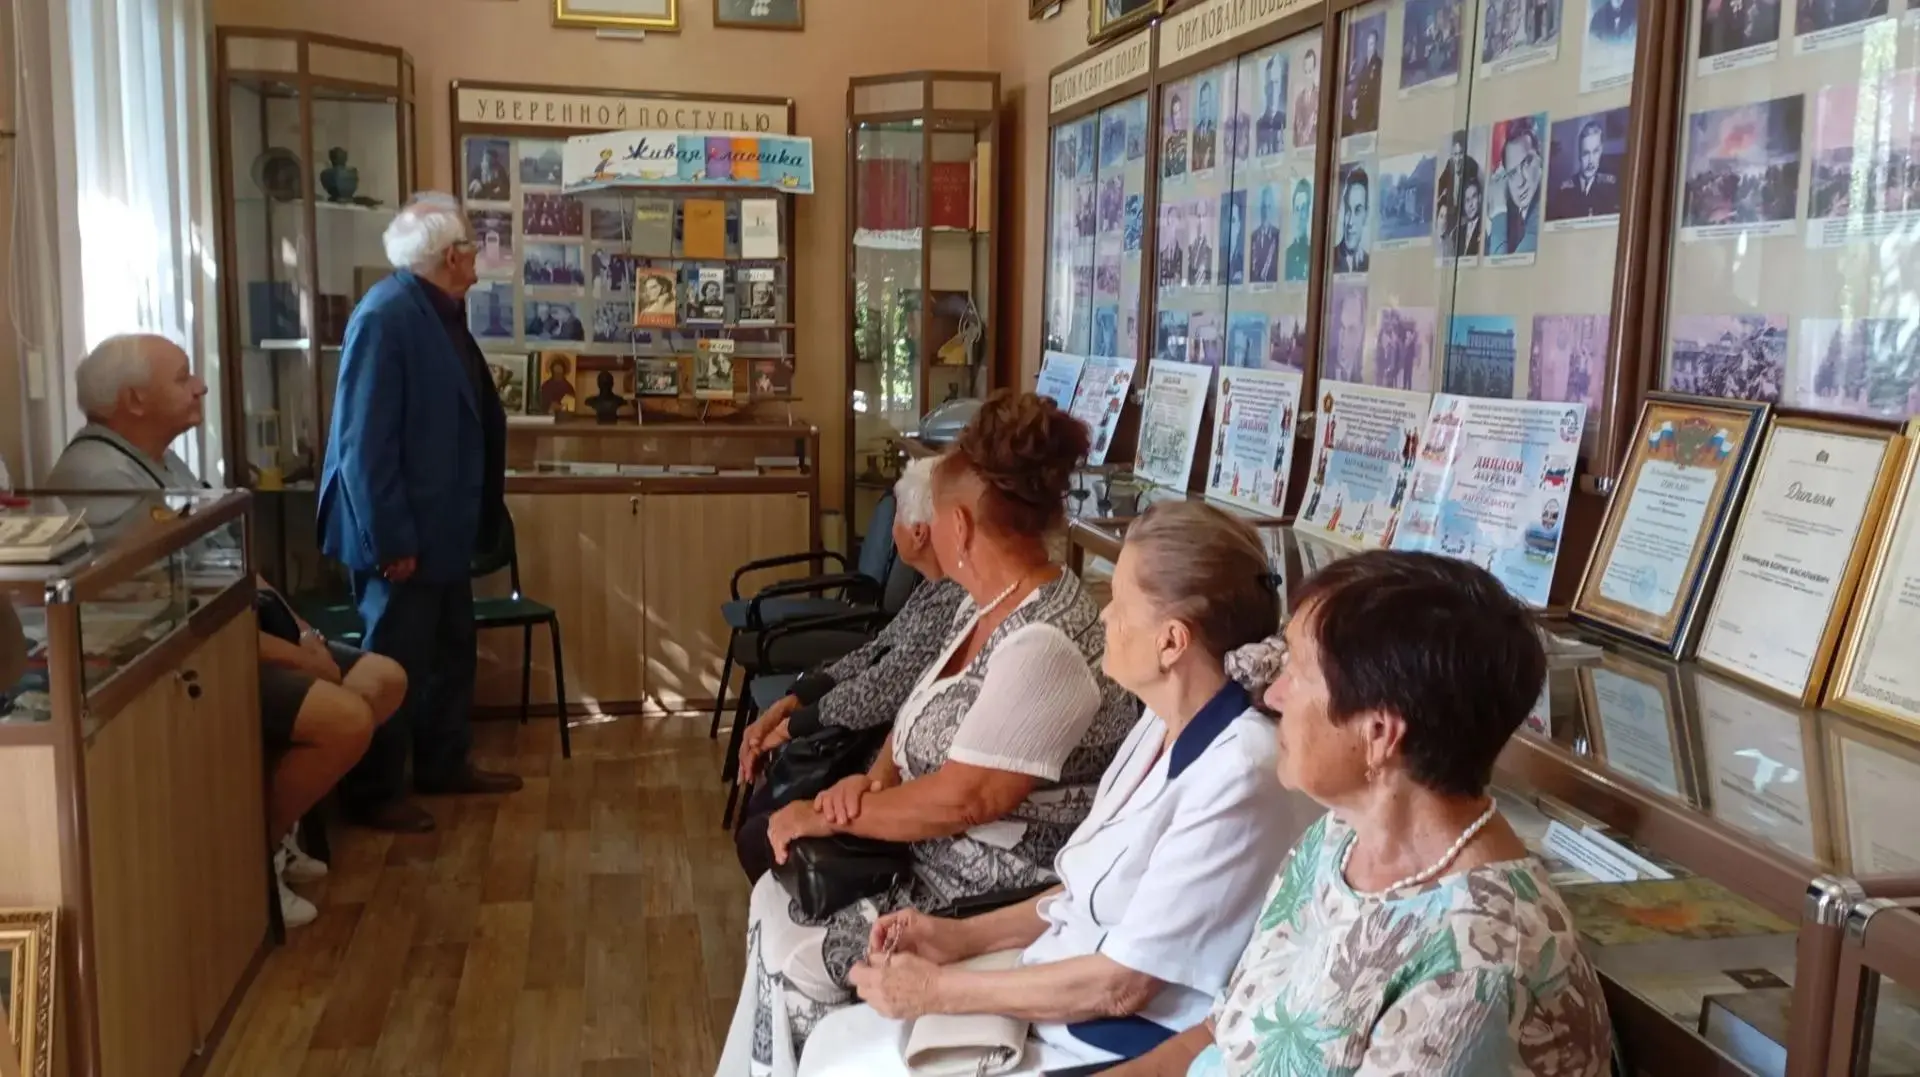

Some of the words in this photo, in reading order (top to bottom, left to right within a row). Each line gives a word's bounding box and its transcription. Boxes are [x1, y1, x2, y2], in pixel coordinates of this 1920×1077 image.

[1176, 17, 1198, 51] ОНИ
[1200, 0, 1247, 42] КОВАЛИ
[477, 99, 627, 126] УВЕРЕННОЙ
[638, 106, 770, 132] ПОСТУПЬЮ
[623, 137, 702, 164] Живая
[1472, 456, 1525, 474] ДИПЛОМ
[1474, 472, 1517, 487] ЛАУРЕАТА
[1784, 480, 1836, 508] Диплом
